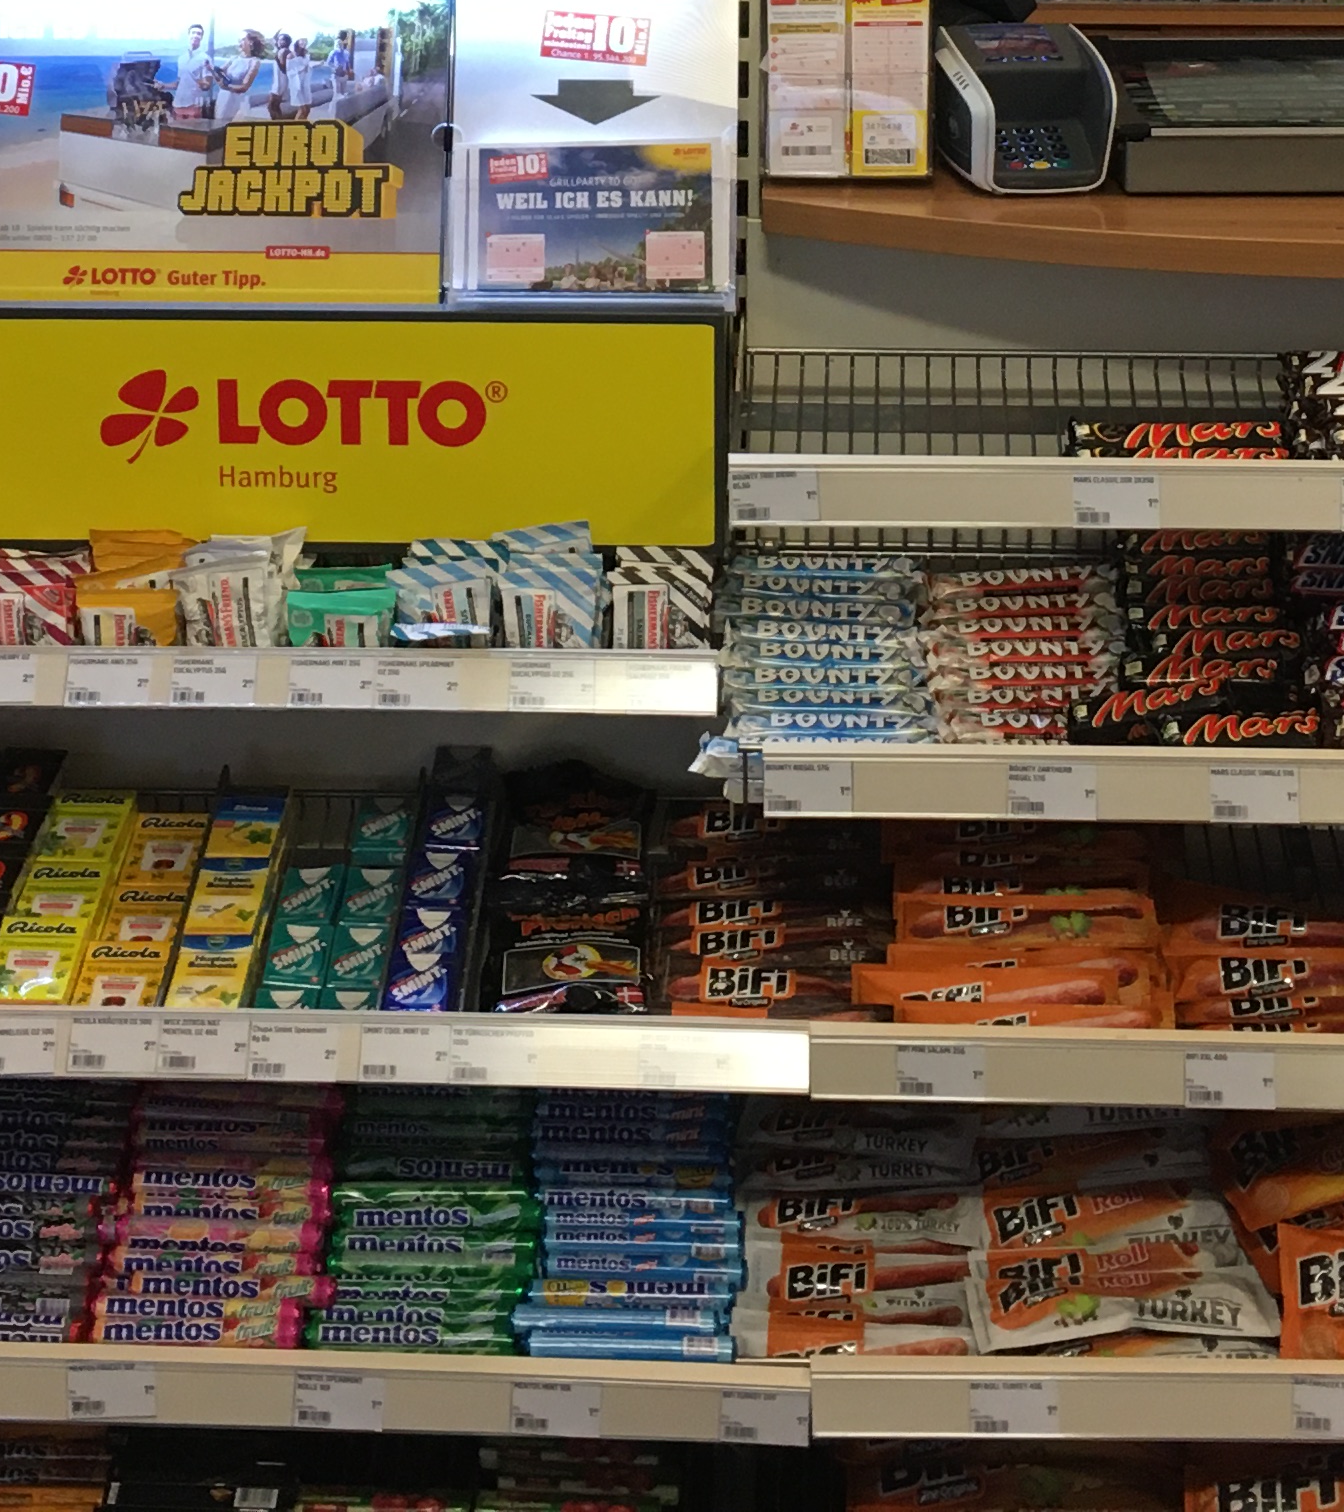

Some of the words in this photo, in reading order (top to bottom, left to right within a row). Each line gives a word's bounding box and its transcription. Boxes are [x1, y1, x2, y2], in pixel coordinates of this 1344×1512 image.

[224, 124, 340, 165] EURO
[179, 169, 382, 213] JACKPOT
[496, 193, 548, 210] WEIL
[555, 191, 589, 208] ICH
[596, 191, 622, 207] ES
[630, 189, 694, 207] KANN!
[91, 268, 156, 285] LOTTO
[167, 270, 217, 286] Guter
[222, 271, 266, 289] Tipp.
[218, 378, 486, 447] LOTTO
[218, 466, 338, 494] Hamburg
[958, 566, 1094, 587] BOUNTY
[1182, 712, 1322, 746] Mars
[91, 947, 162, 962] Ricola
[356, 1207, 468, 1227] mentos
[1134, 1297, 1244, 1328] TURKEY
